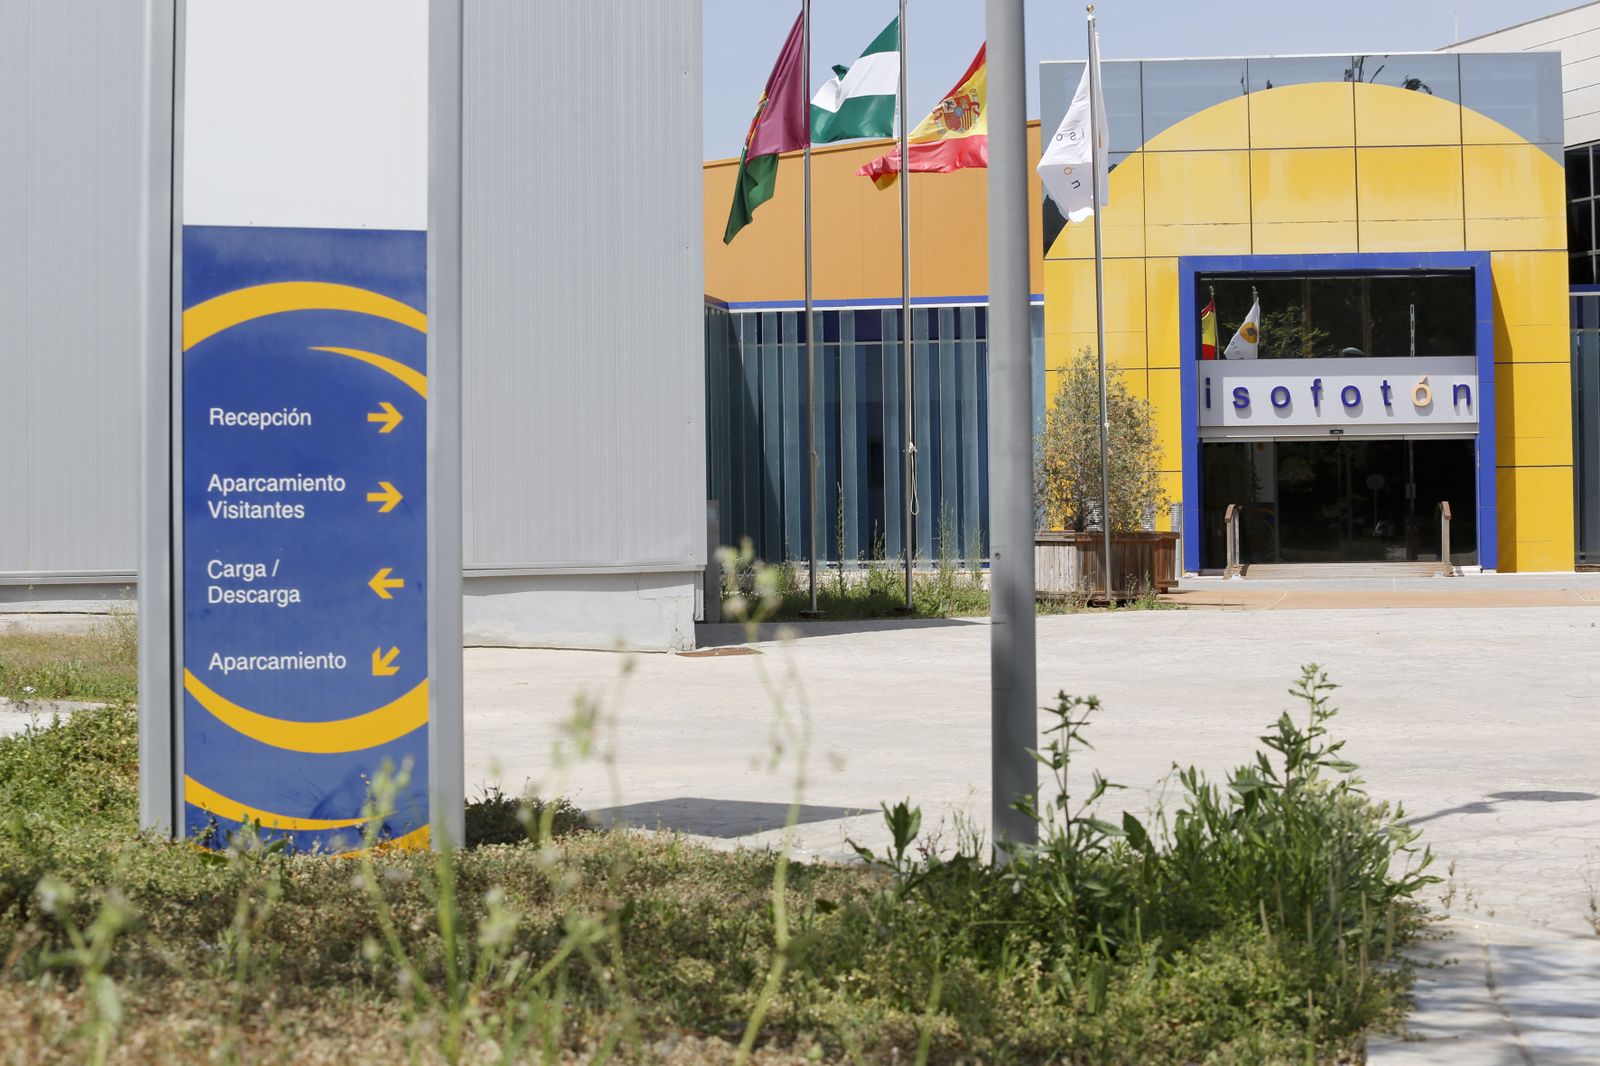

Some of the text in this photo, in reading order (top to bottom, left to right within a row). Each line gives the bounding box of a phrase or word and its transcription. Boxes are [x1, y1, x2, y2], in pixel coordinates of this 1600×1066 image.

[1205, 375, 1472, 409] isofotón
[209, 407, 312, 430] Recepción
[207, 473, 346, 496] Aparcamiento
[207, 500, 305, 520] Visitantes
[207, 559, 267, 582] Carga
[207, 585, 302, 608] Descarga
[208, 651, 347, 675] Aparcamiento
